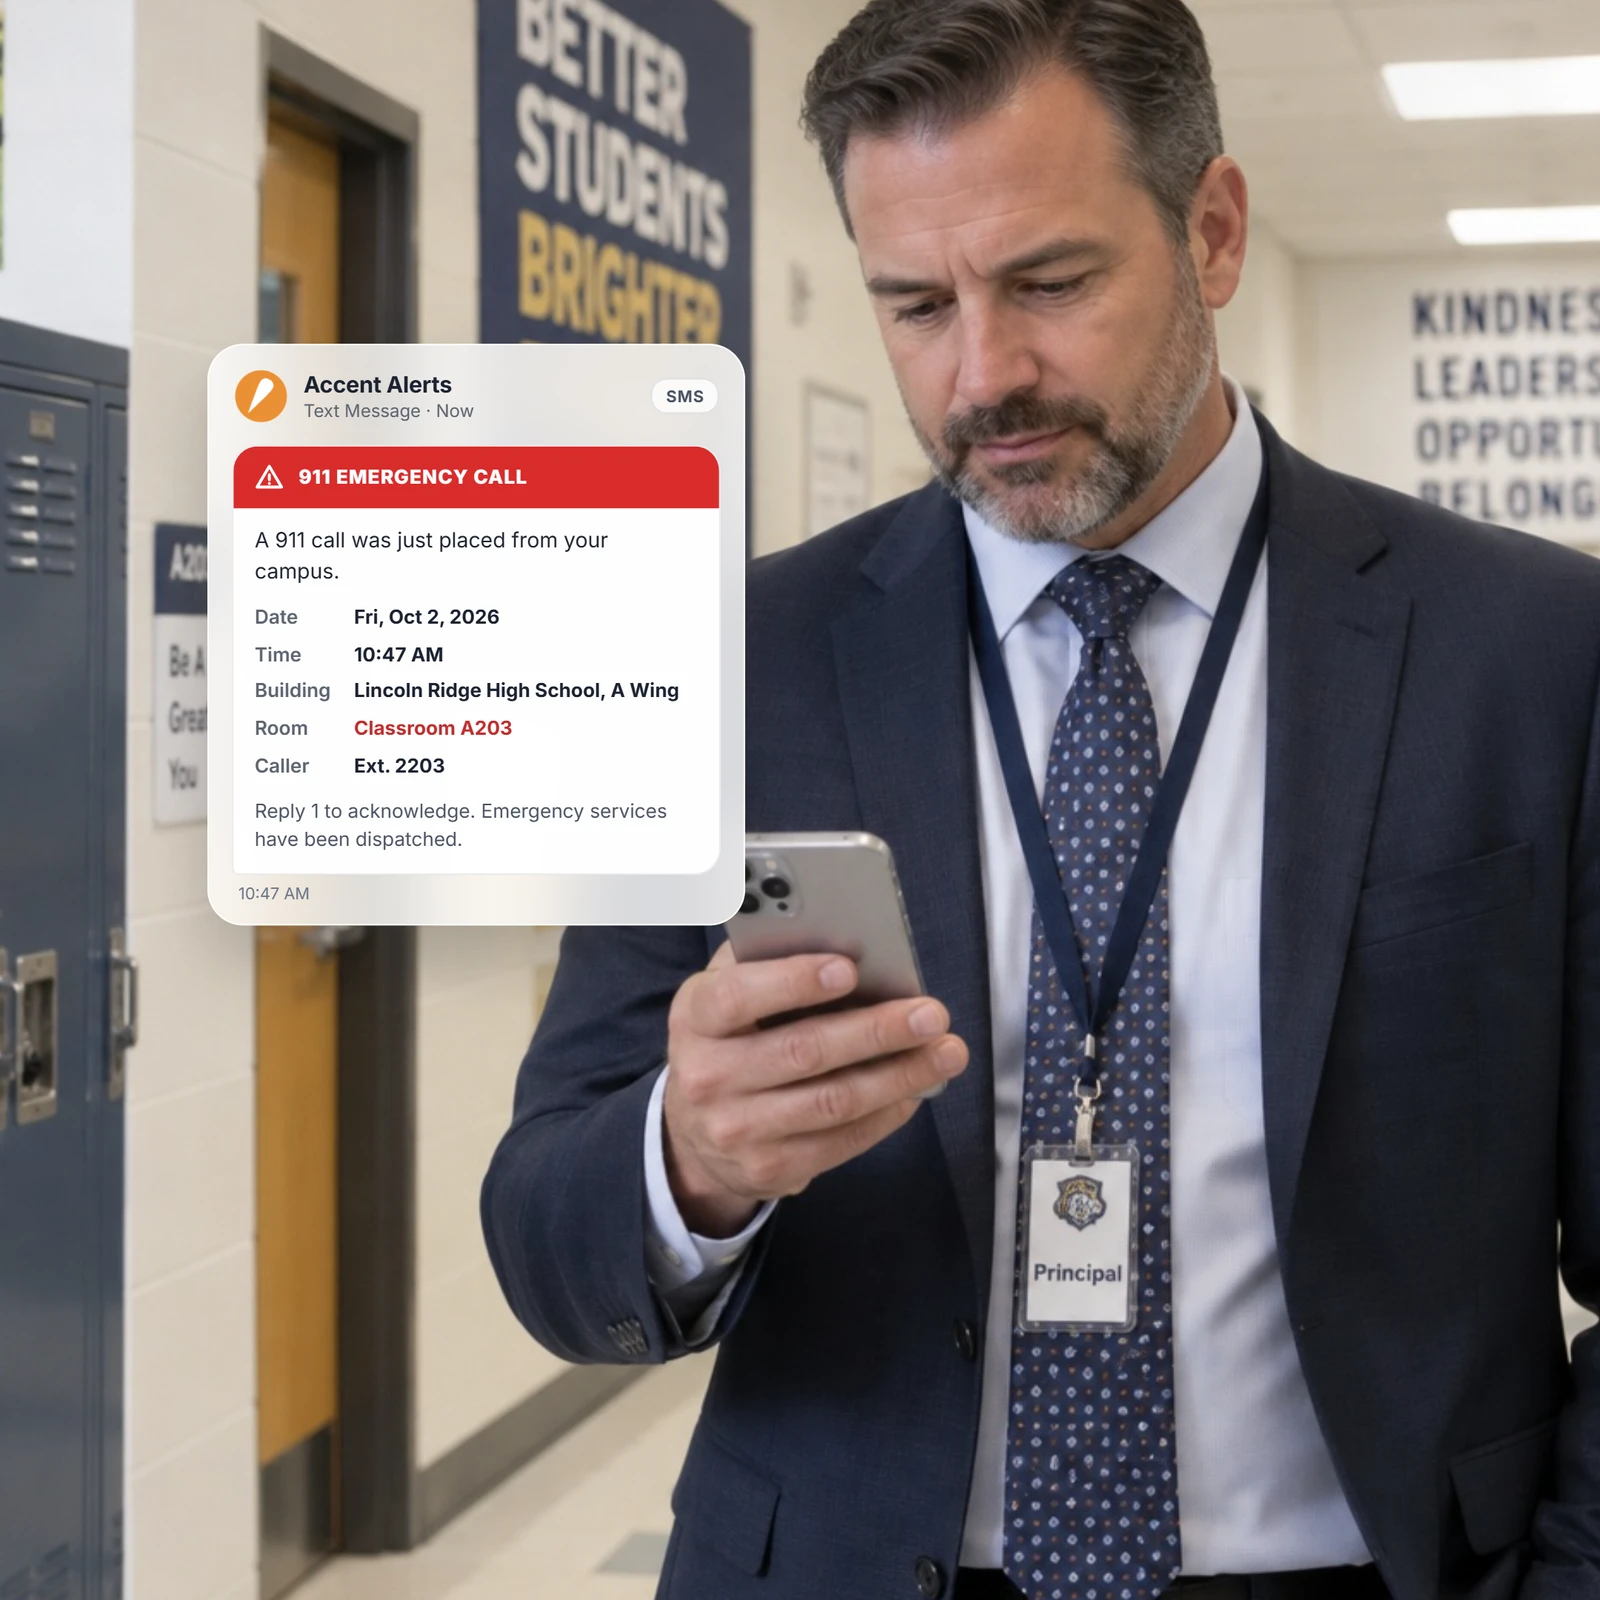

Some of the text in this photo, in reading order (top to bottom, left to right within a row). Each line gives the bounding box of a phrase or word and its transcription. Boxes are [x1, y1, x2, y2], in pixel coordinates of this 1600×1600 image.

[516, 0, 688, 145] BETTER
[515, 83, 729, 270] STUDENTS
[518, 209, 722, 343] BRIGHTER
[169, 542, 207, 582] A20
[170, 644, 205, 677] Be A
[168, 701, 207, 734] Grea
[168, 757, 198, 790] You
[1034, 1264, 1122, 1286] Principal
